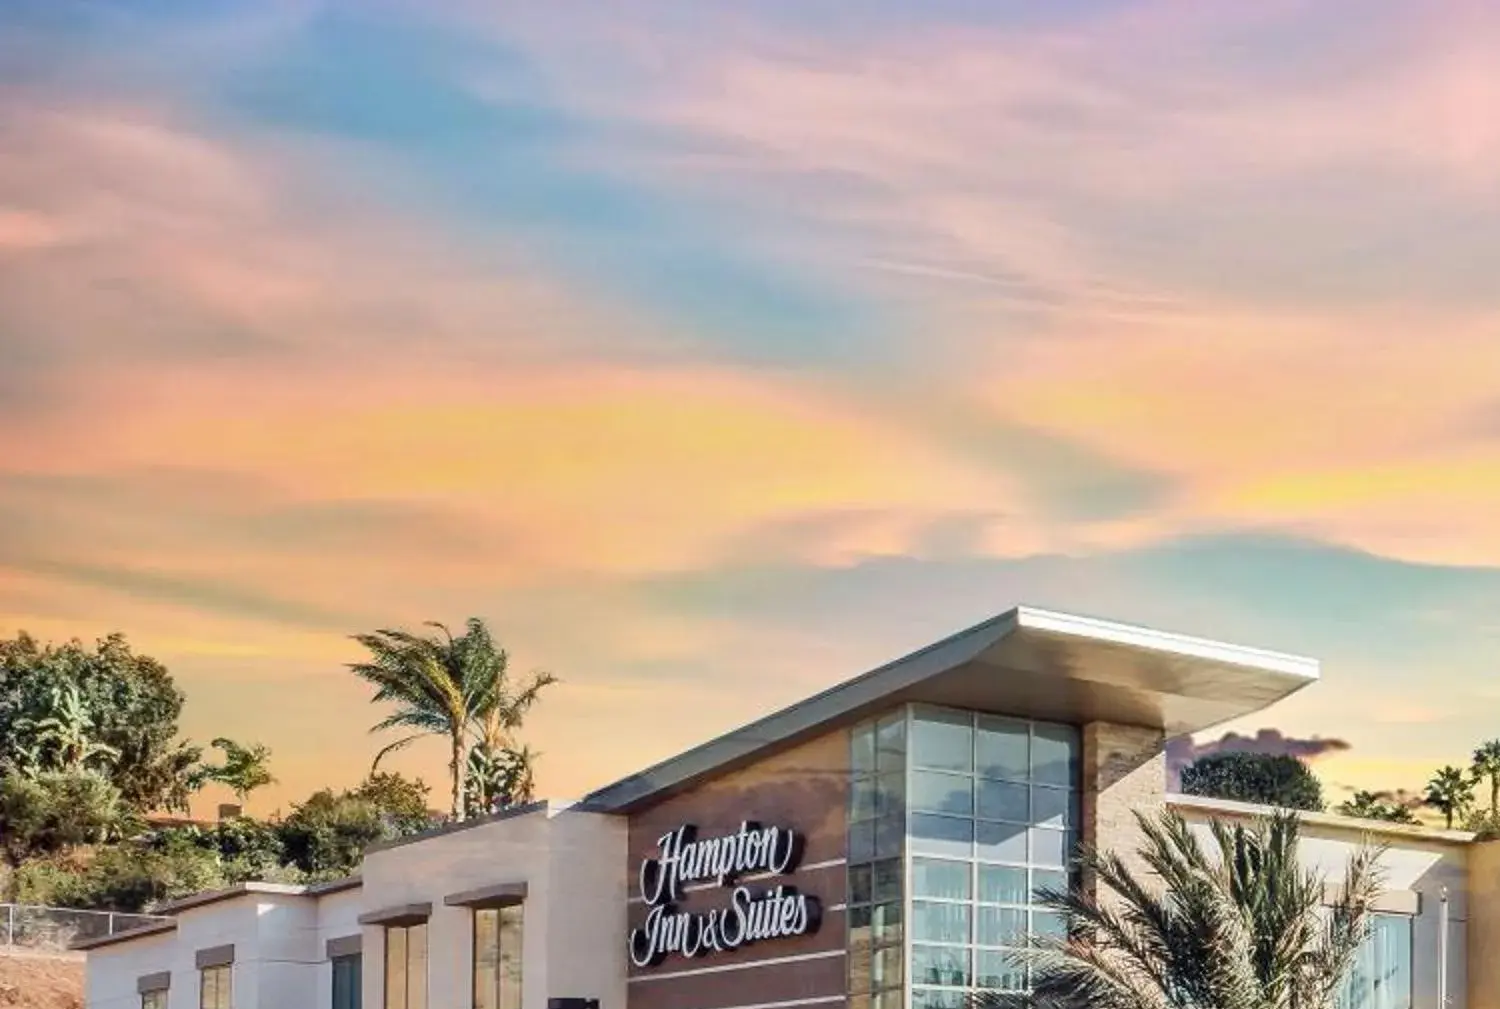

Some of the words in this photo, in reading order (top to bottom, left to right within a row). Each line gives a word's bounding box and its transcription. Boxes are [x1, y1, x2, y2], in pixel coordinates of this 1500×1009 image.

[639, 820, 793, 905] Hampton
[630, 903, 703, 967] Inn
[702, 909, 722, 951] &
[720, 885, 808, 946] Suites
